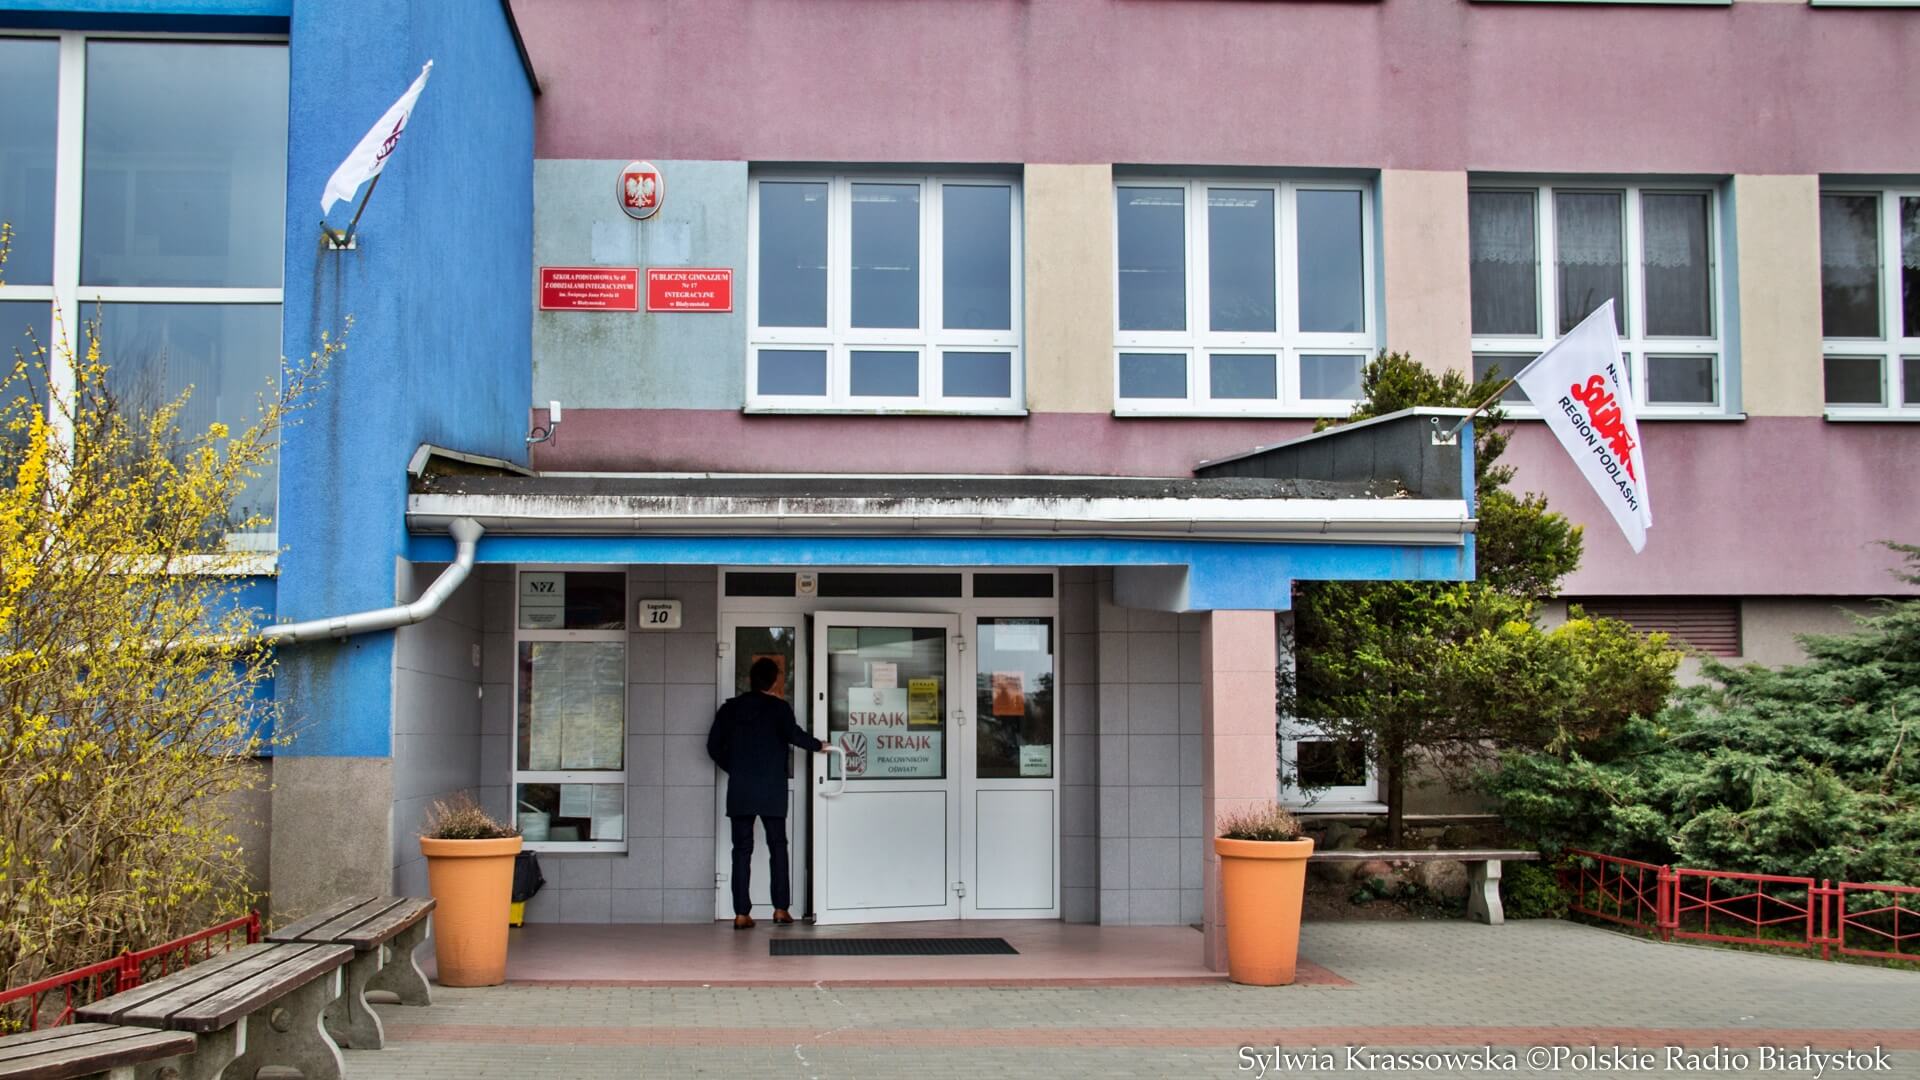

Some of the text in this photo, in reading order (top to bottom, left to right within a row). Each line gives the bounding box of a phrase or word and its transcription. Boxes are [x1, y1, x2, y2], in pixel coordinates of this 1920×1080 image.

[1558, 396, 1639, 511] REGION PODLASKI
[530, 582, 555, 593] NFZ
[650, 611, 668, 623] 10
[849, 711, 905, 728] STRAJK
[876, 735, 931, 751] STRAJK
[877, 755, 929, 763] PRACOWNIKÓW
[887, 765, 918, 773] OŚWIATY
